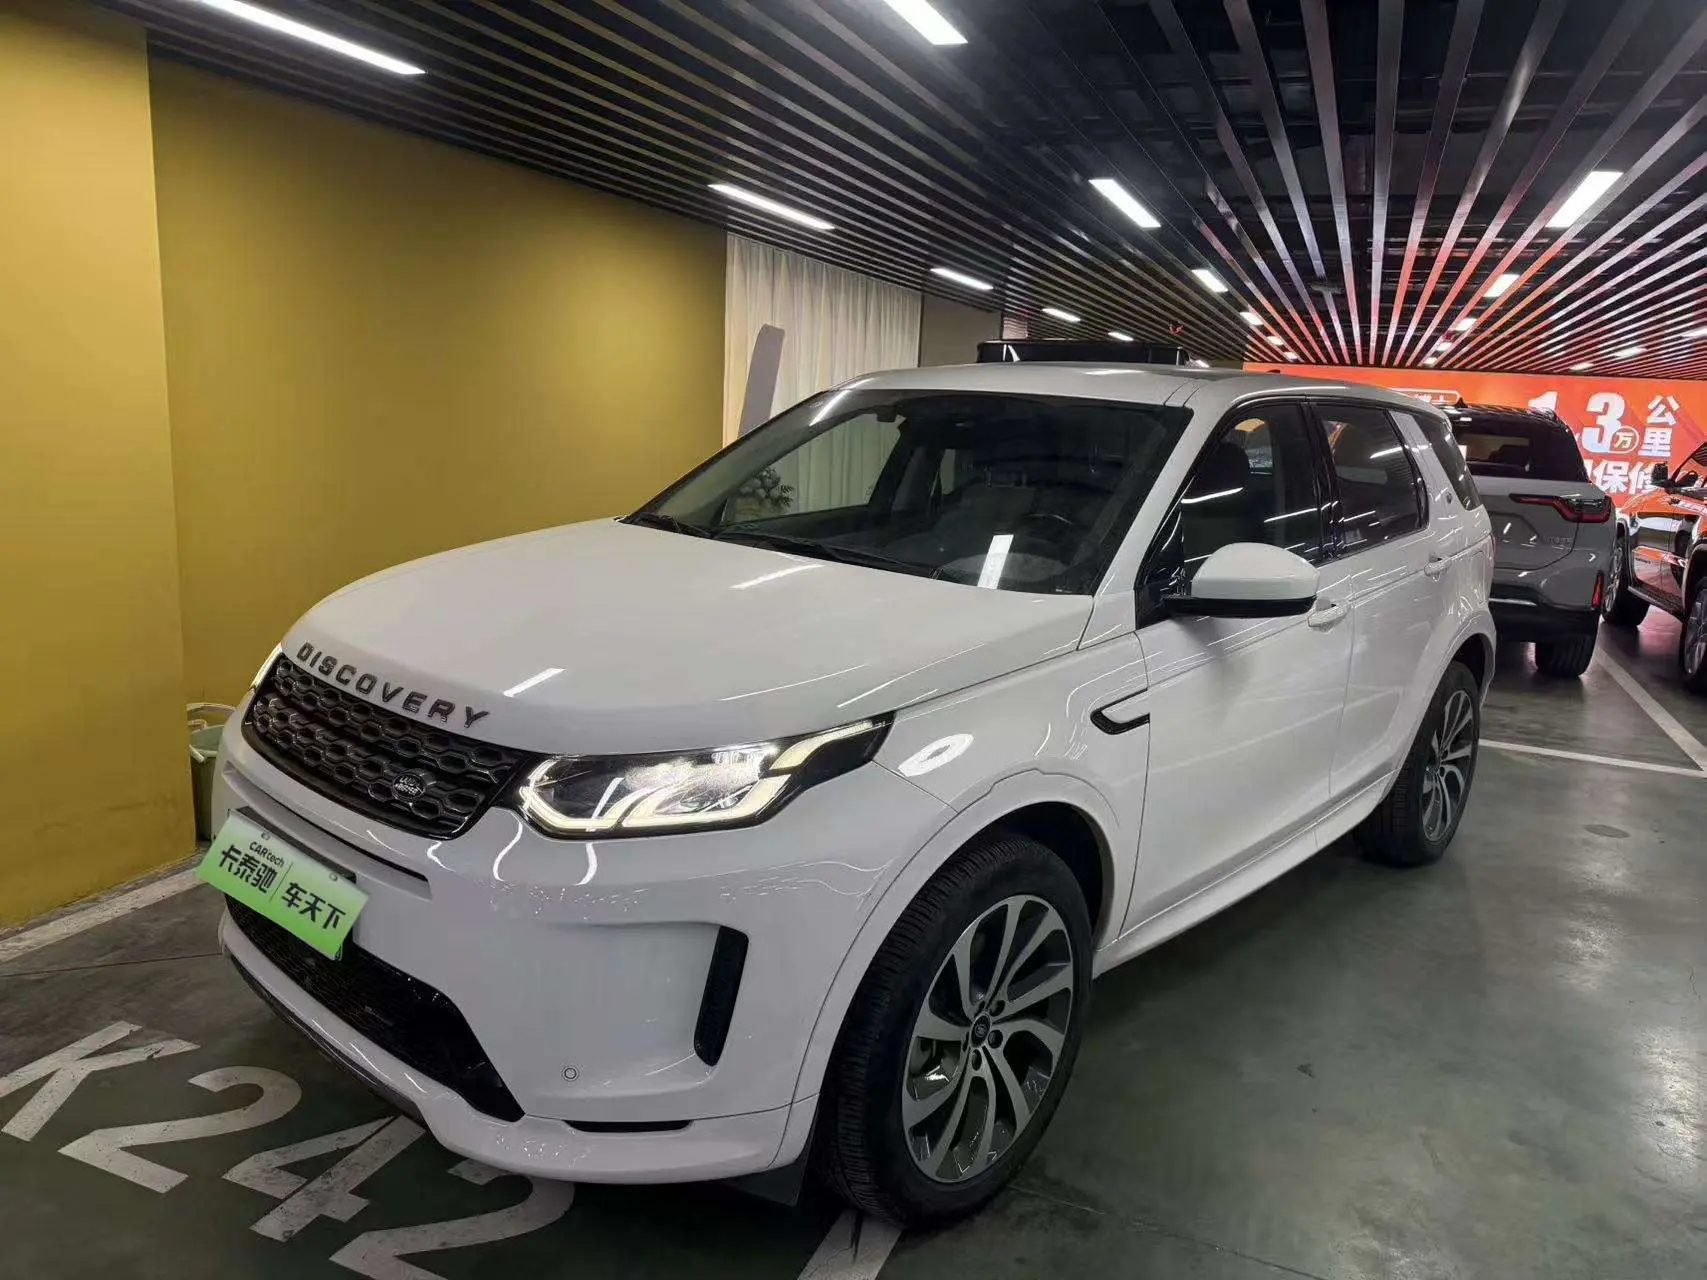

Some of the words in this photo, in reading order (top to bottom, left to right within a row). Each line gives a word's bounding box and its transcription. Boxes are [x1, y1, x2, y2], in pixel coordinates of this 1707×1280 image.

[1585, 459, 1656, 495] 保修
[297, 642, 490, 729] DISCOVERY
[219, 844, 278, 894] 卡泰驰
[281, 882, 346, 930] 车天下
